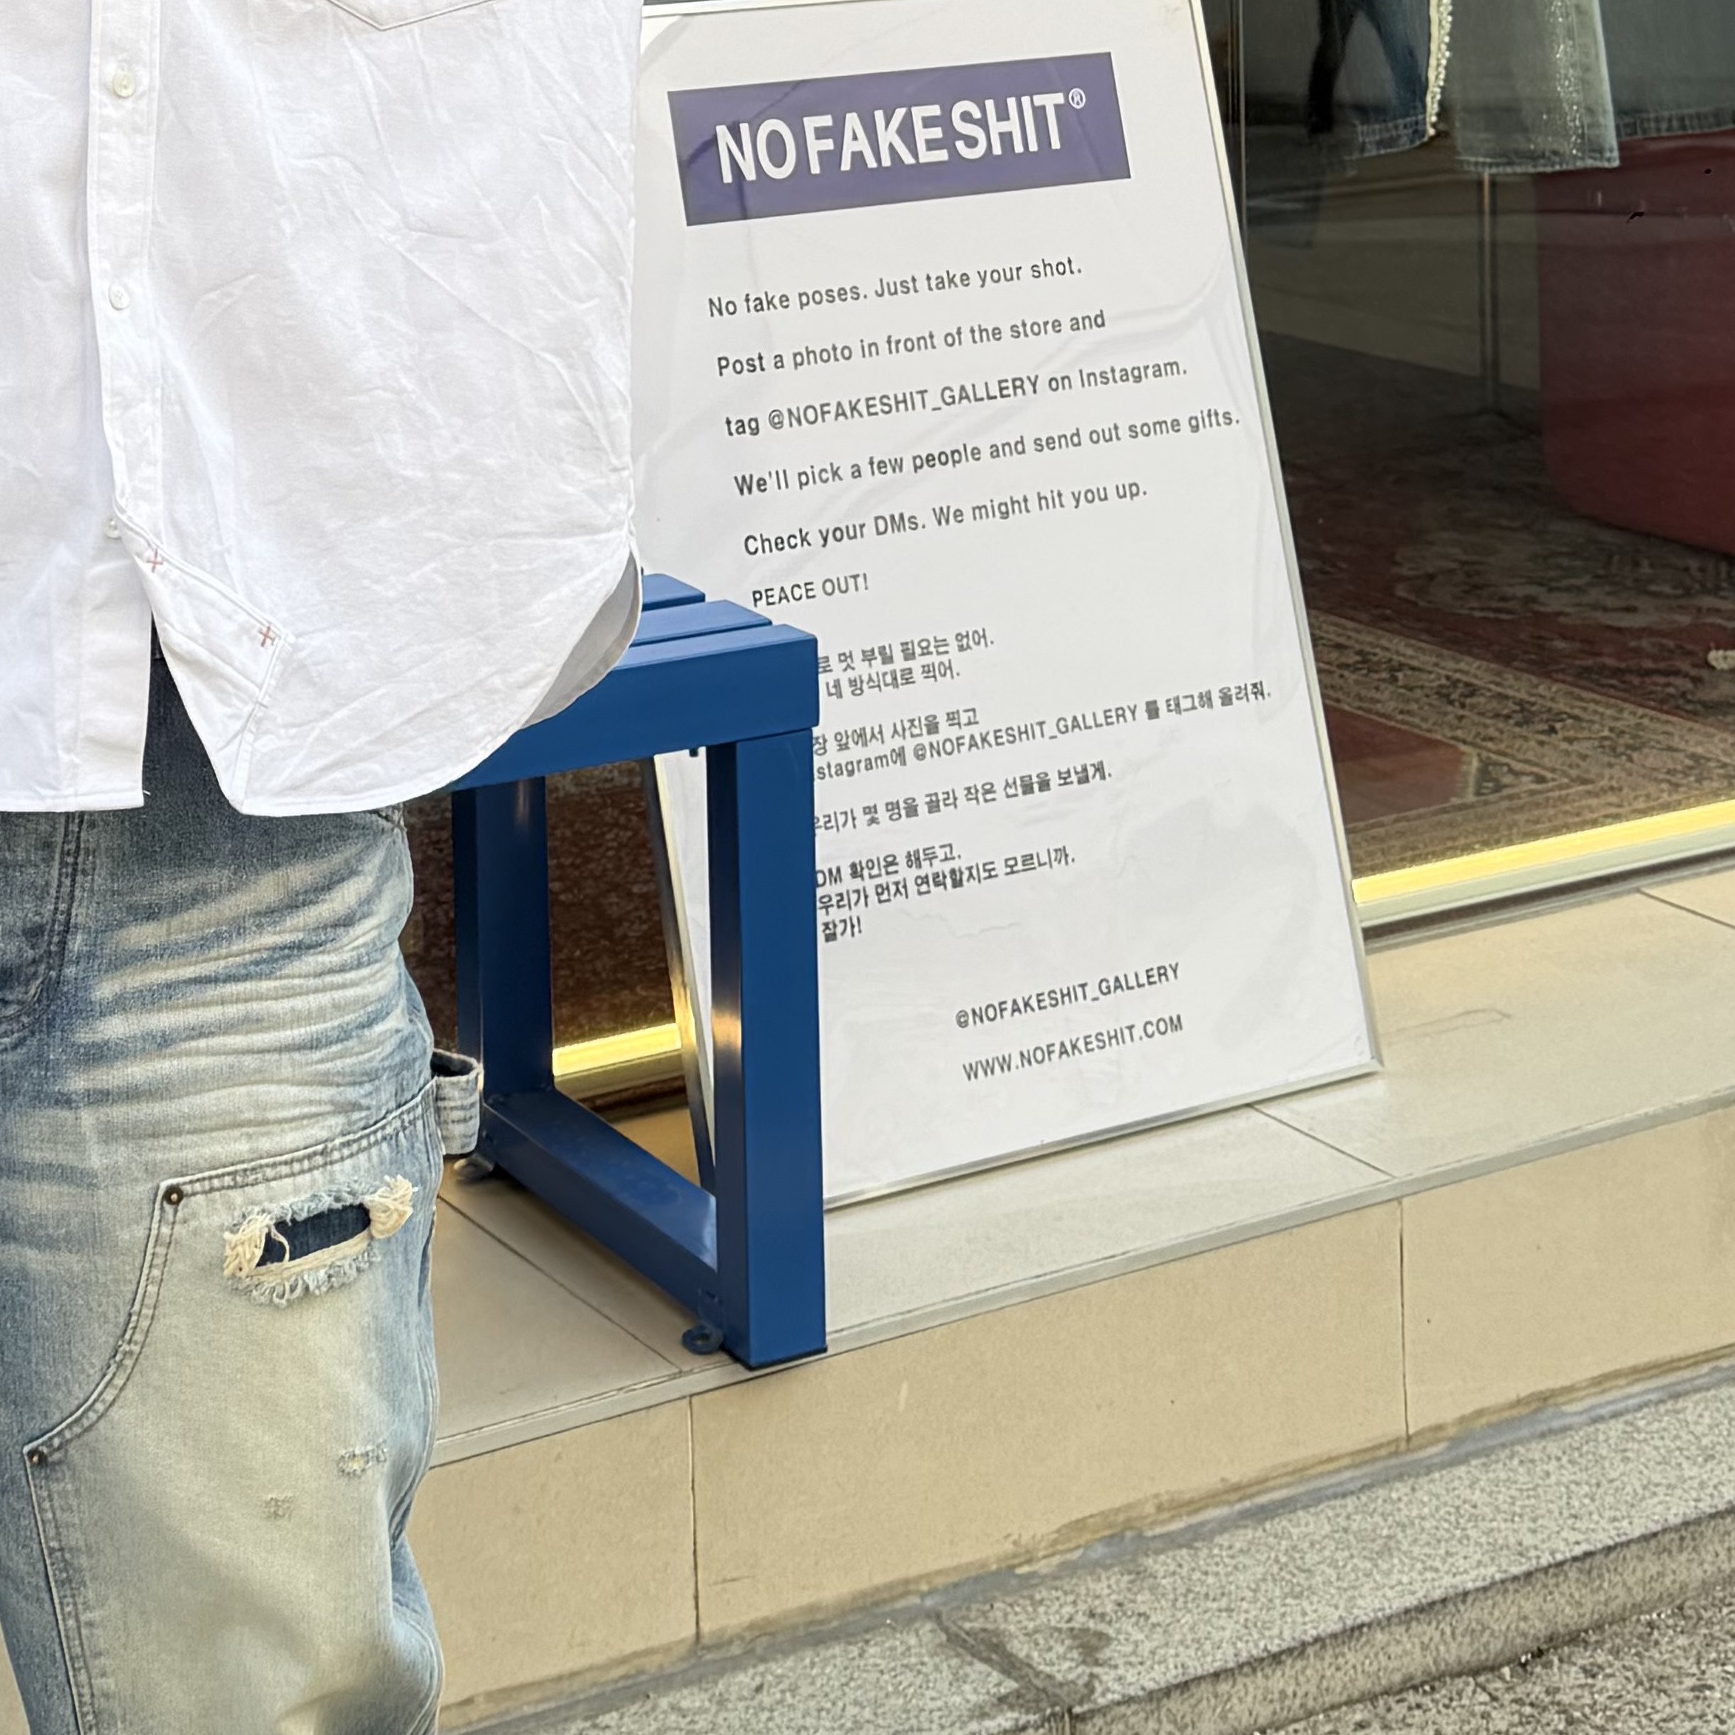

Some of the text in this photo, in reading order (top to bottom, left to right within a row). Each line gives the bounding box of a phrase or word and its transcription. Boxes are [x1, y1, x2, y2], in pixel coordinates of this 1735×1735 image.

[707, 256, 1082, 318] No fake poses. Just take your shot.
[716, 308, 1106, 377] Post a photo in front of the store and
[724, 360, 1187, 437] tag @NOFAKESHIT_GALLERY on Instagram.
[733, 408, 1240, 497] We'll pick a few people and send out some gifts.
[743, 481, 1147, 556] Check your DMs. We might hit you up.
[751, 572, 869, 609] PEACE OUT!
[825, 658, 961, 700] 네 방식대로 찍어.
[837, 649, 856, 673] 멋
[860, 642, 895, 669] 부릴
[899, 635, 950, 662] 필요는
[954, 627, 995, 653] 없어.
[816, 745, 907, 781] stagram에
[912, 703, 1138, 762] @NOFAKESHIT_GALLERY
[1144, 699, 1161, 721] 를
[1218, 679, 1271, 708] 올려줘.
[833, 723, 886, 753] 앞에서
[890, 713, 940, 741] 사진을
[945, 707, 980, 730] 찍고
[861, 802, 881, 827] 몇
[884, 796, 920, 822] 명을
[924, 787, 959, 815] 골라
[963, 781, 997, 806] 작은
[1002, 771, 1052, 800] 선물을
[1056, 759, 1112, 787] 보낼게.
[815, 842, 962, 888] DM 확인은 해두고.
[818, 844, 1076, 917] 우리가 먼저 연락할지도 모르니까.
[821, 914, 863, 944] 잘가!
[955, 961, 1179, 1029] @NOFAKESHIT_GALLERY
[962, 1013, 1183, 1082] WWW.NOFAKESHIT.COM
